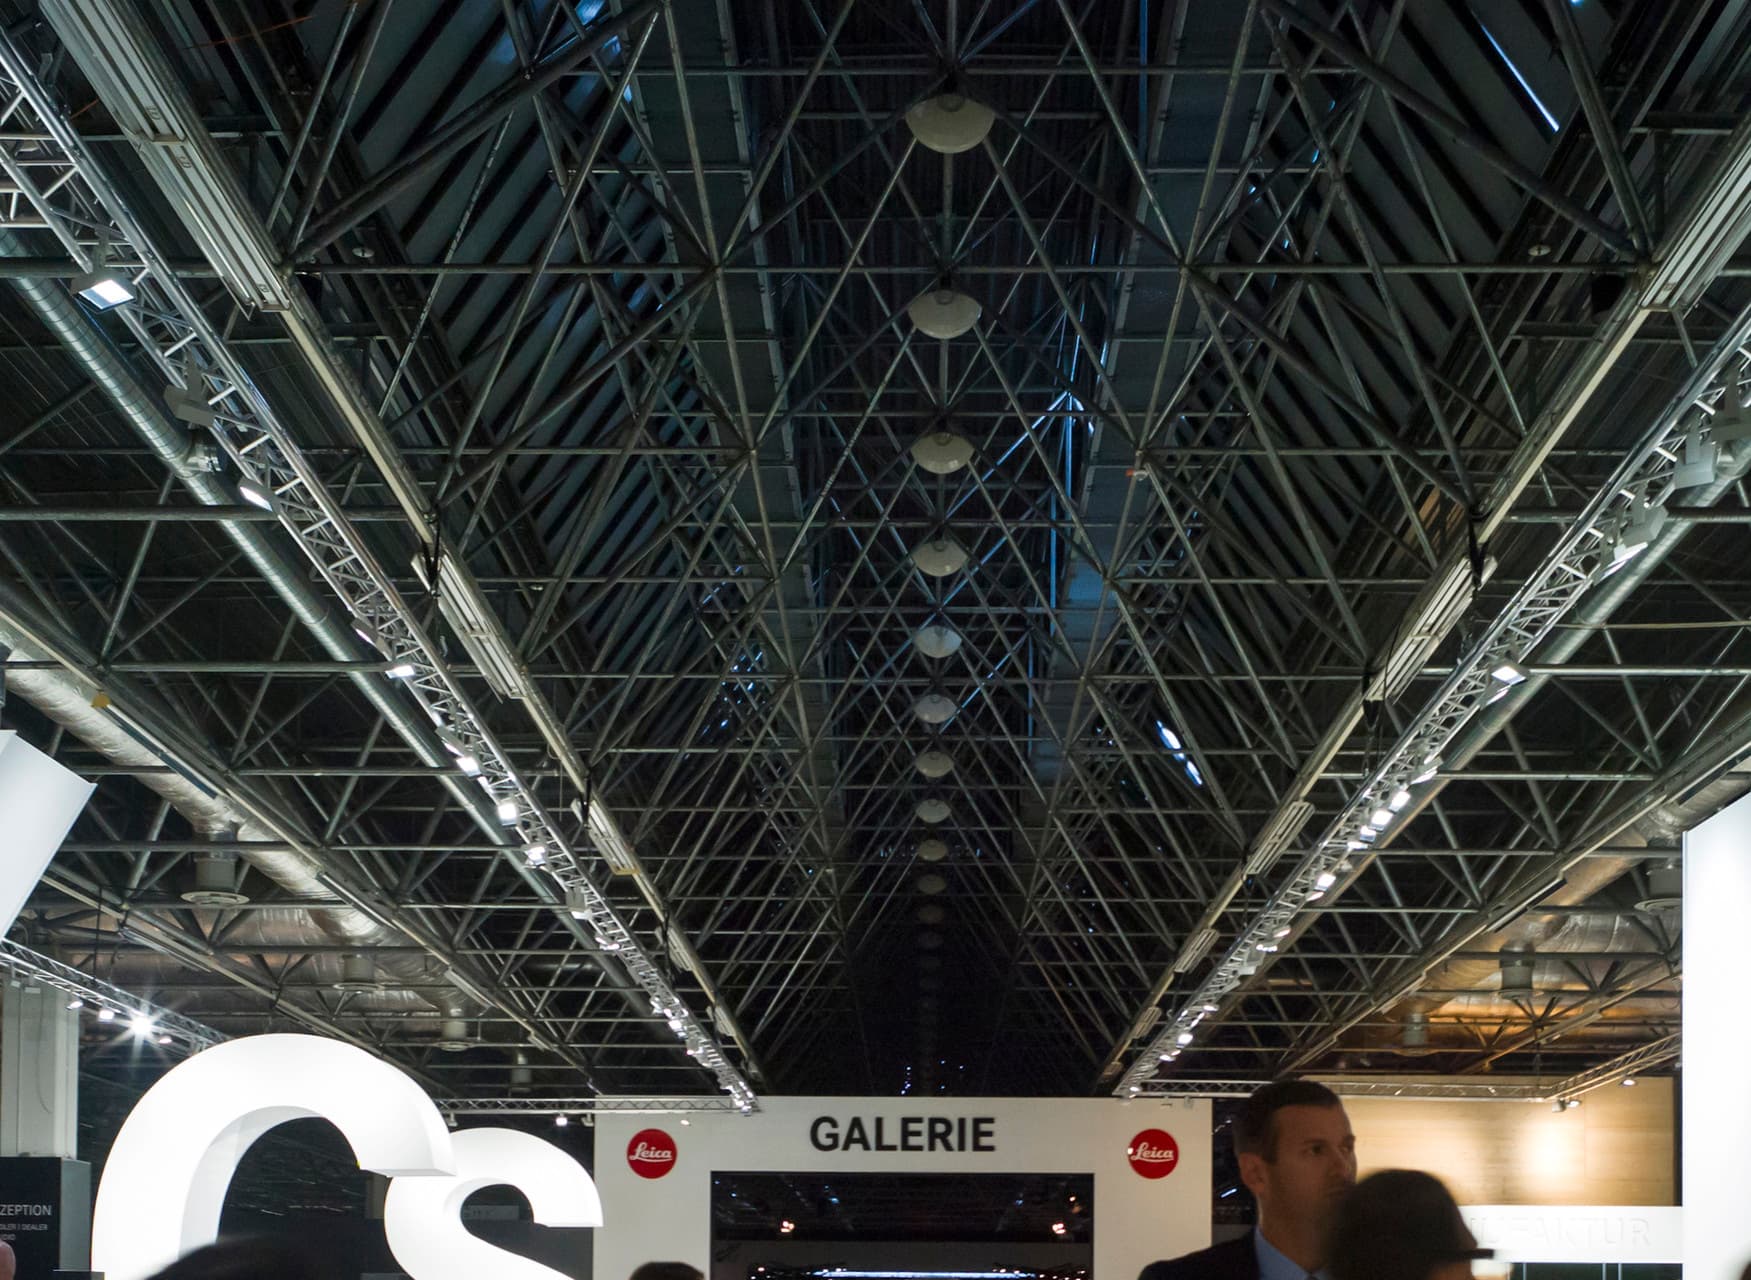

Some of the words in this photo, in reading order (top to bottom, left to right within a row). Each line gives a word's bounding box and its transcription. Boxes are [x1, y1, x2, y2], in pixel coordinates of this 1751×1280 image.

[809, 1115, 996, 1152] GALERIE
[628, 1141, 673, 1163] Leica
[1130, 1141, 1175, 1163] Leica
